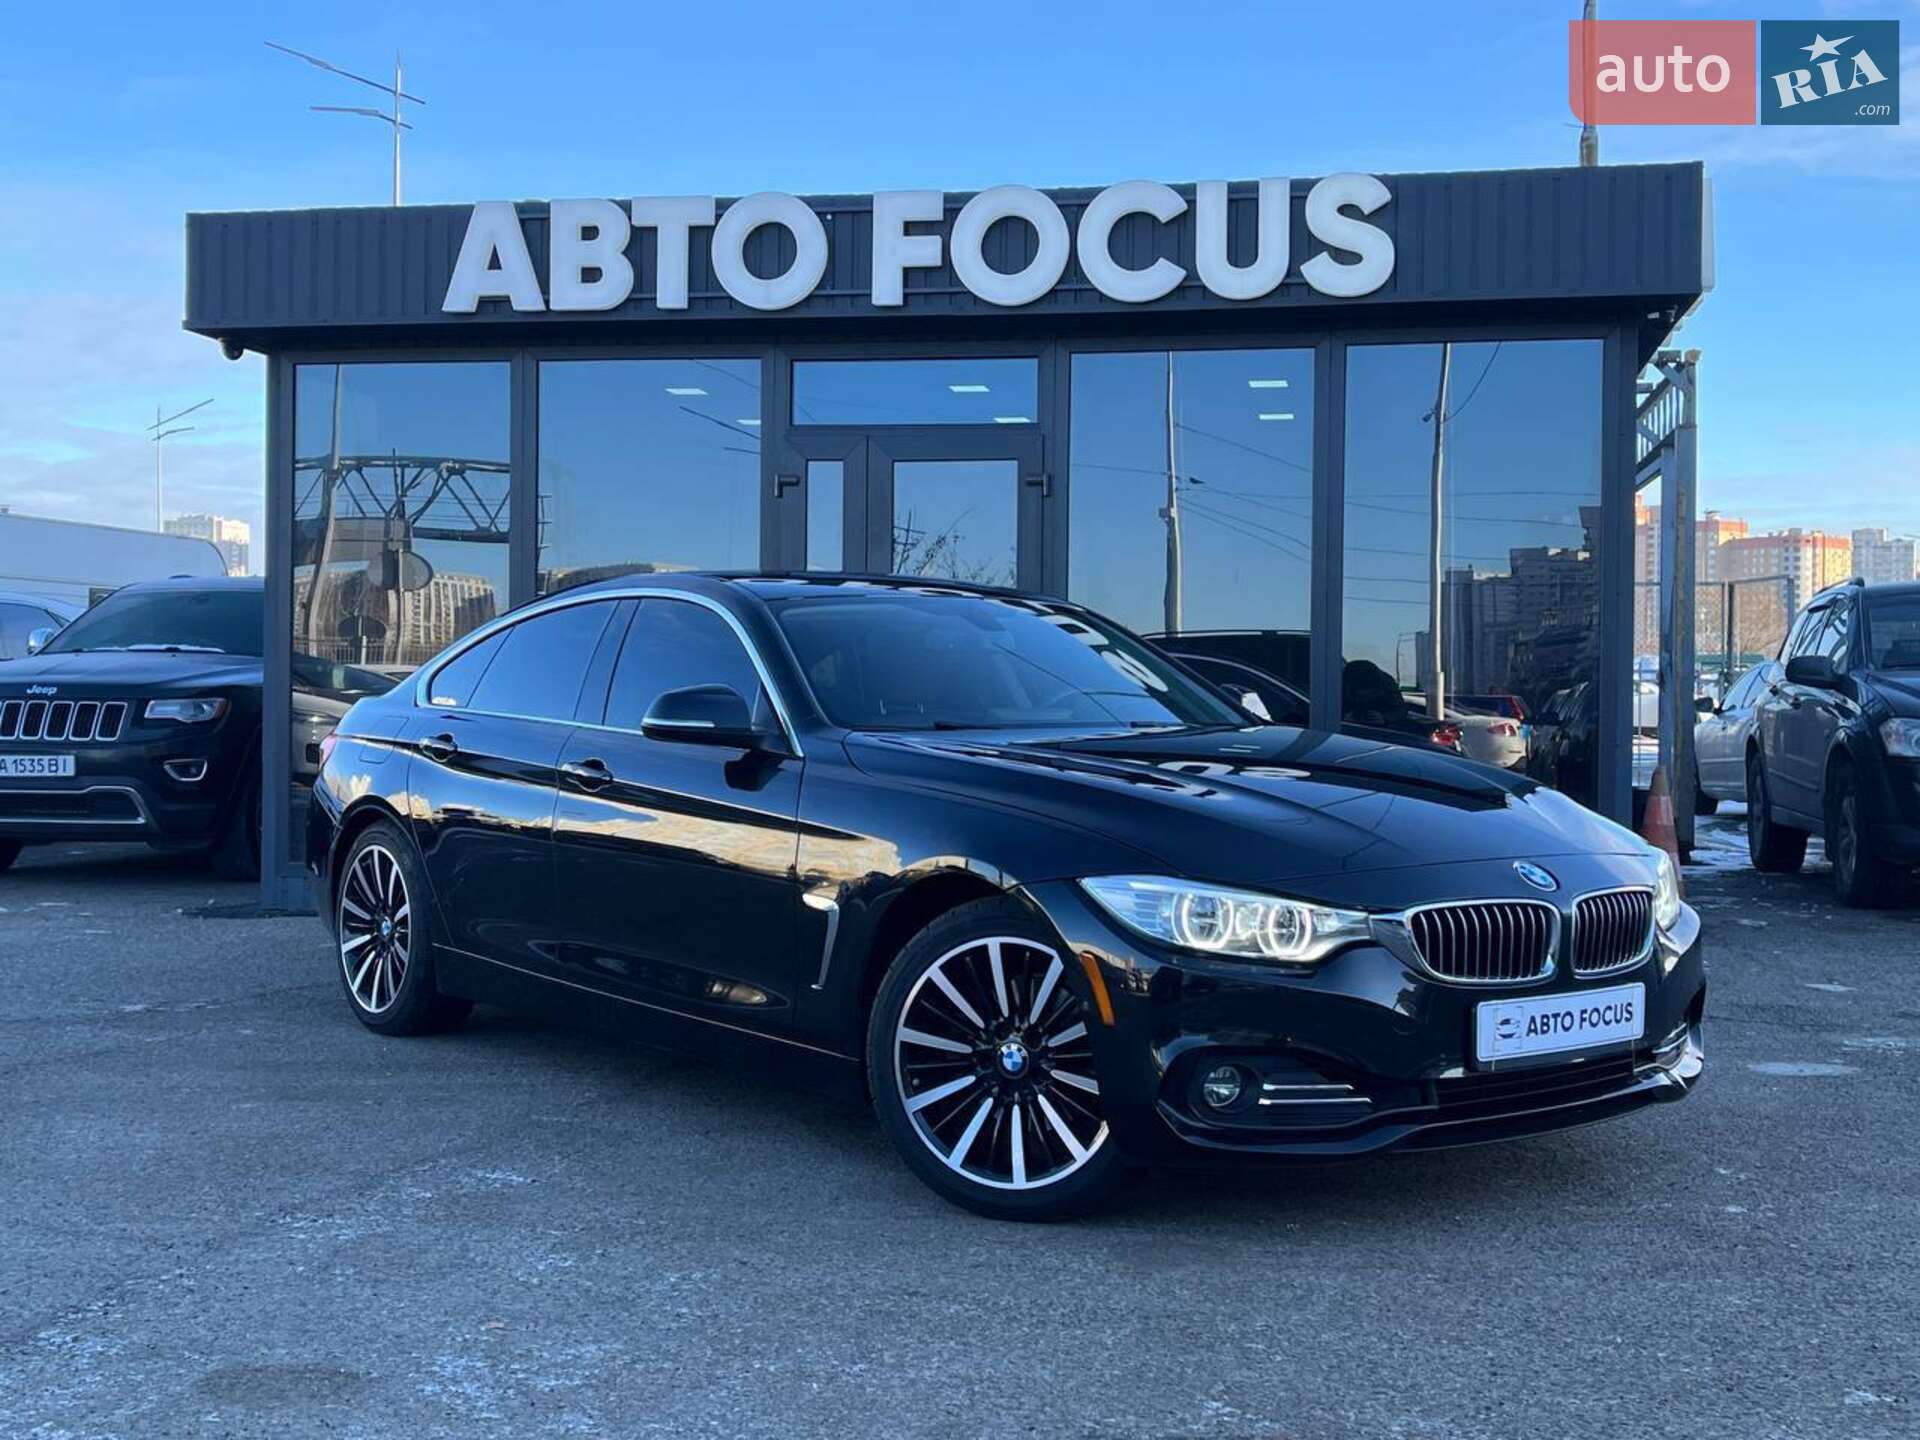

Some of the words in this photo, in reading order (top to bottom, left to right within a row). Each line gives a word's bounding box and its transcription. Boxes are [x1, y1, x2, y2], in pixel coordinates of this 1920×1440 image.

[442, 192, 829, 313] АВТО
[871, 172, 1397, 306] FOCUS
[26, 684, 58, 696] Jeep
[1526, 1010, 1574, 1037] АВТО
[1579, 1002, 1633, 1030] FOCUS
